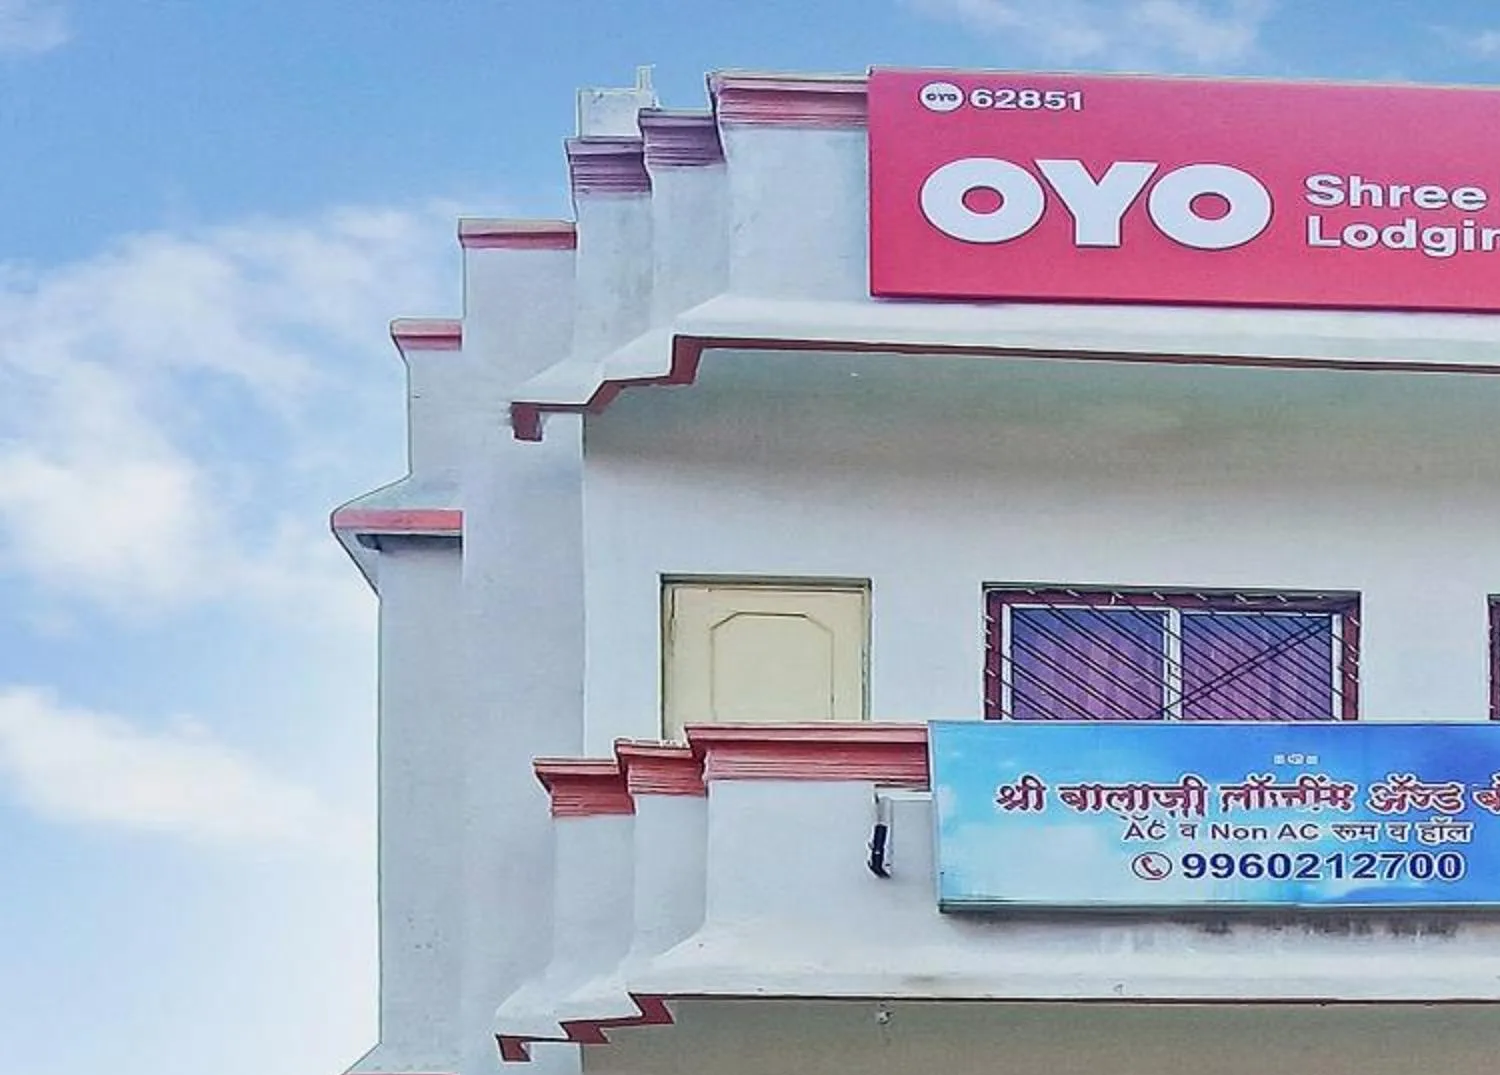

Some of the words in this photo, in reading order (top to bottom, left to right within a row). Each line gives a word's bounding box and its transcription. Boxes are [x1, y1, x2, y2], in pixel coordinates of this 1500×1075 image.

[969, 89, 1083, 111] 62851
[919, 156, 1274, 250] OYO
[1304, 173, 1488, 211] Shree
[996, 775, 1047, 811] श्री
[1124, 820, 1167, 841] AC
[1180, 822, 1197, 841] व
[1210, 823, 1268, 841] Non
[1277, 823, 1320, 841] AC
[1332, 822, 1378, 843] रूम
[1387, 822, 1408, 842] व
[1417, 817, 1474, 845] हॉल
[1180, 852, 1465, 881] 9960212700
